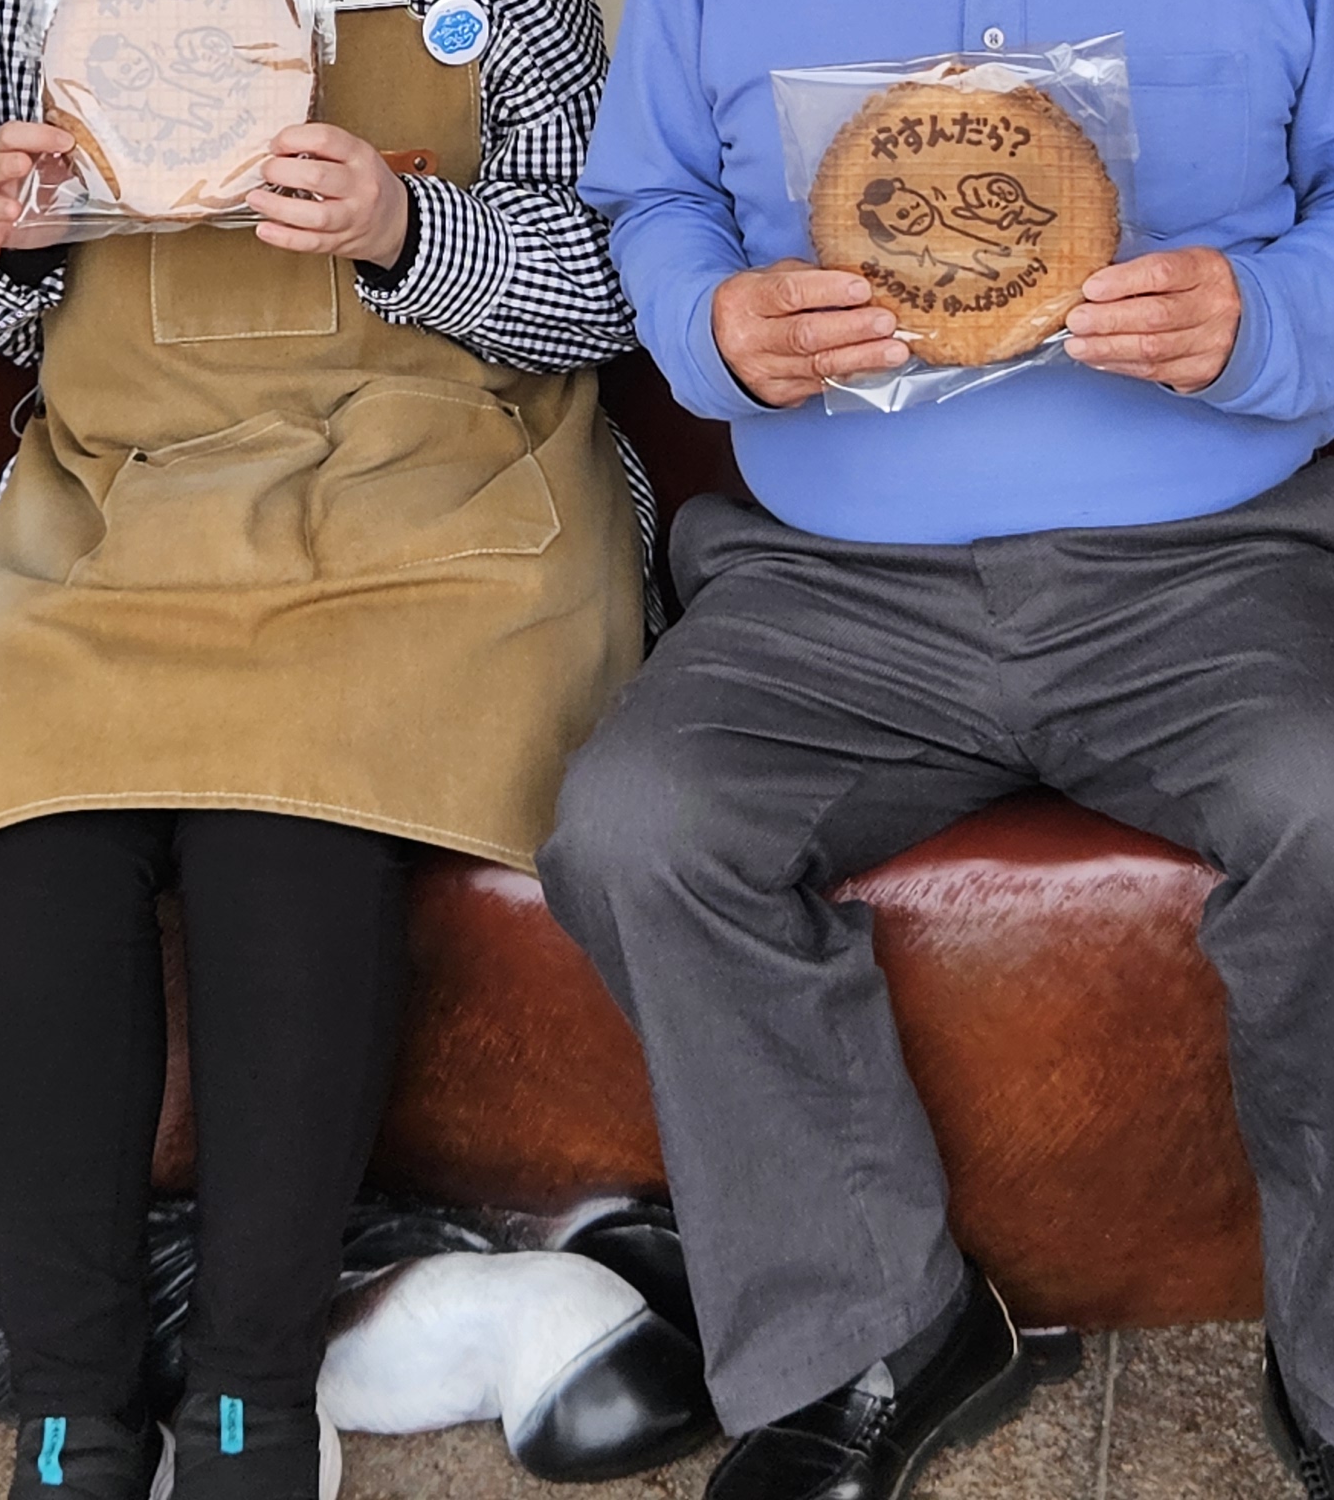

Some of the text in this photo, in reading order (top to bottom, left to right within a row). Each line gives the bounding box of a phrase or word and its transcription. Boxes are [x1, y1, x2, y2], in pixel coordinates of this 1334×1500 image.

[870, 111, 1032, 163] やすんだら?
